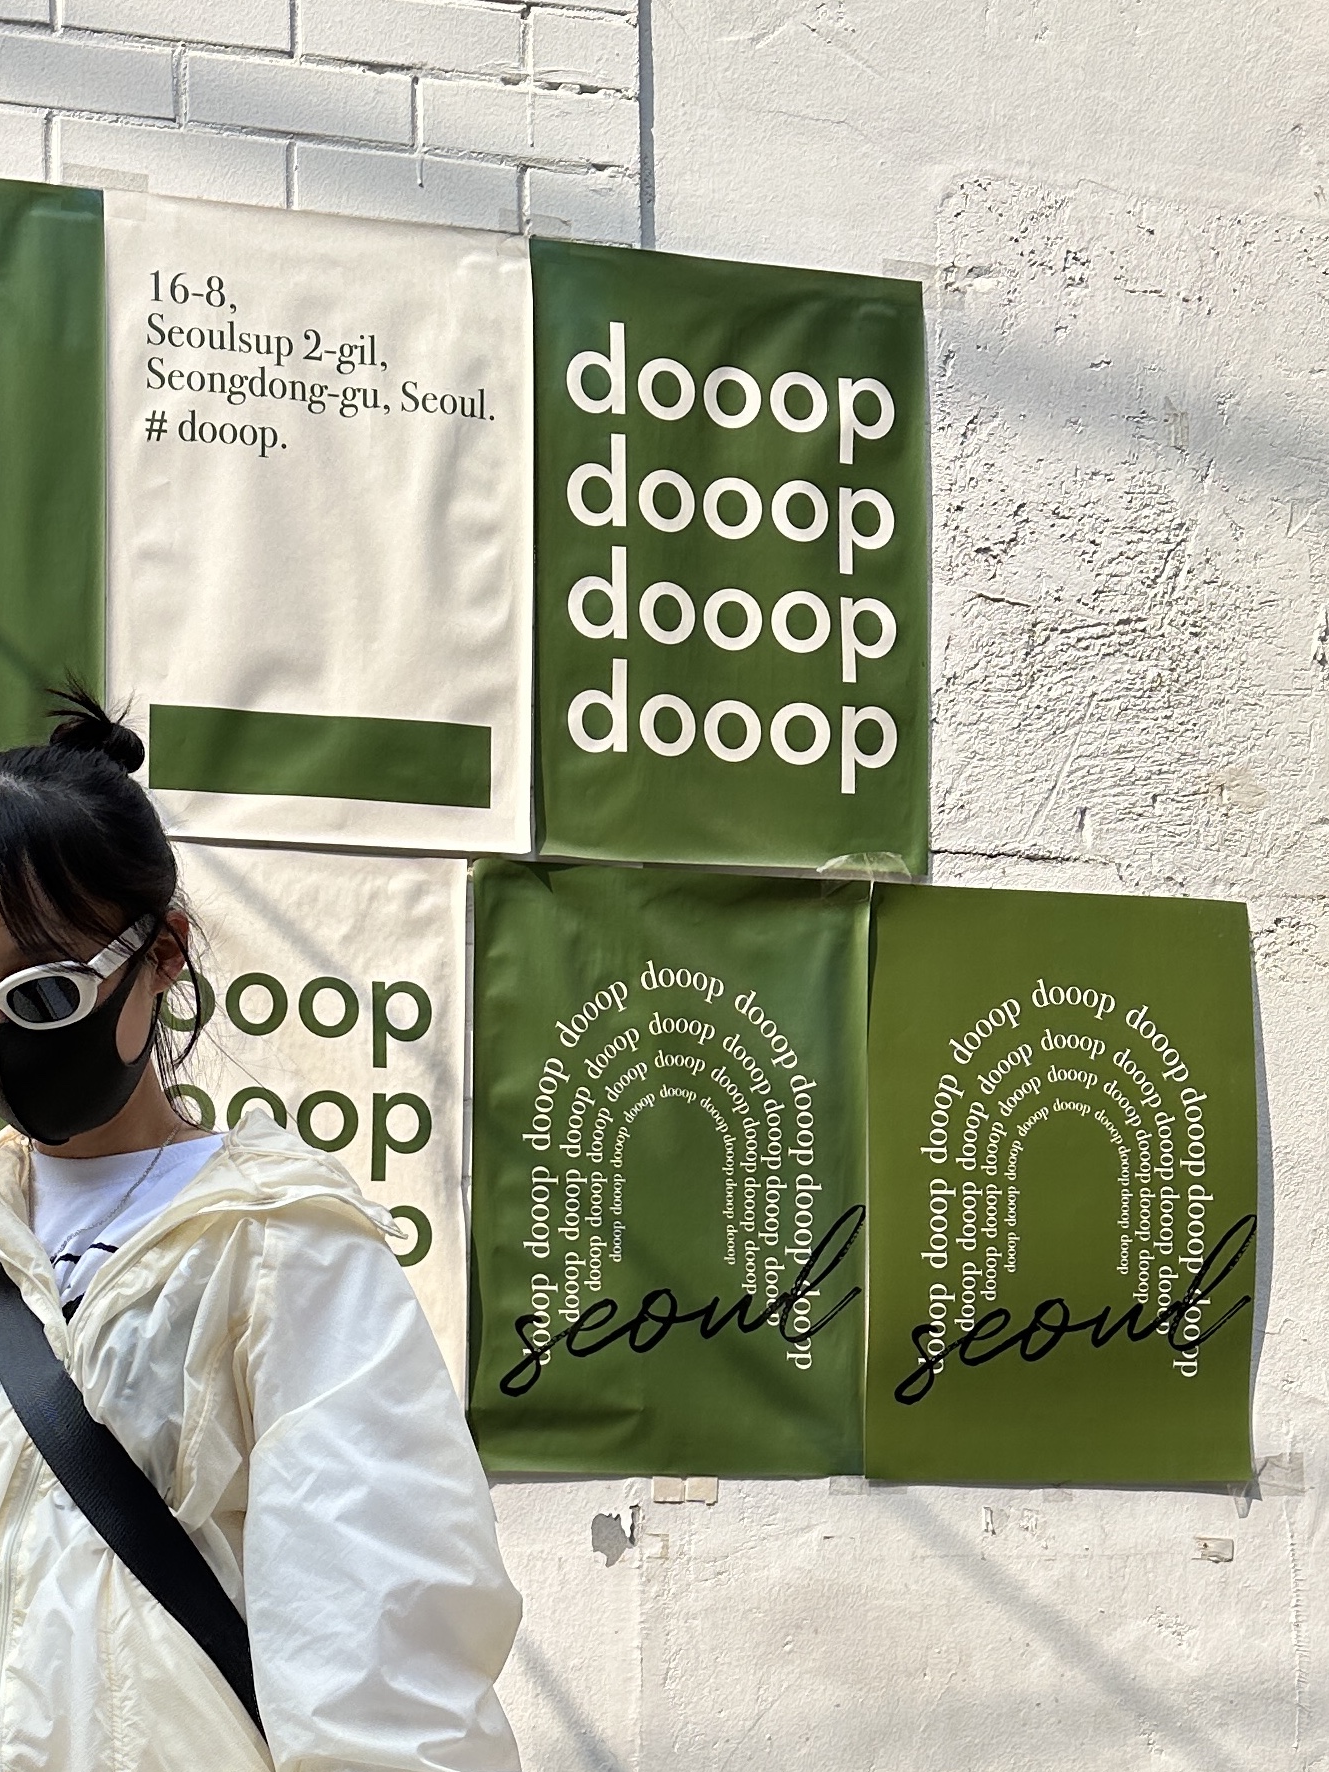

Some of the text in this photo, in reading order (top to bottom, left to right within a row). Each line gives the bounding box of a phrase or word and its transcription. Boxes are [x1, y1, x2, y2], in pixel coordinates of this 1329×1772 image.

[150, 270, 238, 314] 16-8,
[146, 313, 389, 373] Seoulsup 2-gil,
[145, 357, 497, 422] Seongdong-gu, Seoul.
[566, 322, 895, 465] dooop
[178, 410, 288, 458] dooop.
[566, 434, 895, 575] dooop
[567, 546, 897, 683] dooop
[567, 659, 898, 795] dooop
[555, 981, 628, 1048] dooop
[640, 959, 725, 1004] dooop
[1031, 978, 1116, 1021] dooop
[160, 971, 433, 1068] ooop
[583, 1027, 640, 1080] dooop
[648, 1011, 716, 1045] dooop
[734, 989, 798, 1069] dooop
[948, 998, 1021, 1065] dooop
[1040, 1028, 1106, 1060] dooop
[1125, 1004, 1189, 1082] dooop
[722, 1033, 771, 1095] dooop
[976, 1043, 1033, 1095] dooop
[1112, 1047, 1162, 1108] dooop
[522, 1057, 571, 1150] dooop
[559, 1086, 596, 1158] dooop
[760, 1098, 785, 1170] dooop
[788, 1074, 817, 1166] dooop
[920, 1073, 965, 1164] dooop
[955, 1101, 990, 1171] dooop
[1179, 1087, 1207, 1177] dooop
[584, 1049, 762, 1295] dooop dooop dooop dooop dooop dooop dooop dooop dooop
[1153, 1111, 1175, 1181] dooop
[523, 1166, 559, 1259] dooop
[558, 1168, 587, 1241] dooop
[758, 1175, 788, 1246] dooop
[784, 1173, 822, 1265] dooop
[955, 1181, 983, 1251] dooop
[980, 1065, 1156, 1304] dooop dooop dooop dooop dooop dooop dooop dooop dooop
[1153, 1186, 1181, 1255] dooop
[921, 1178, 957, 1269] dooop
[1178, 1184, 1214, 1274] dooop
[558, 1251, 586, 1323] dooop
[954, 1261, 982, 1332] dooop
